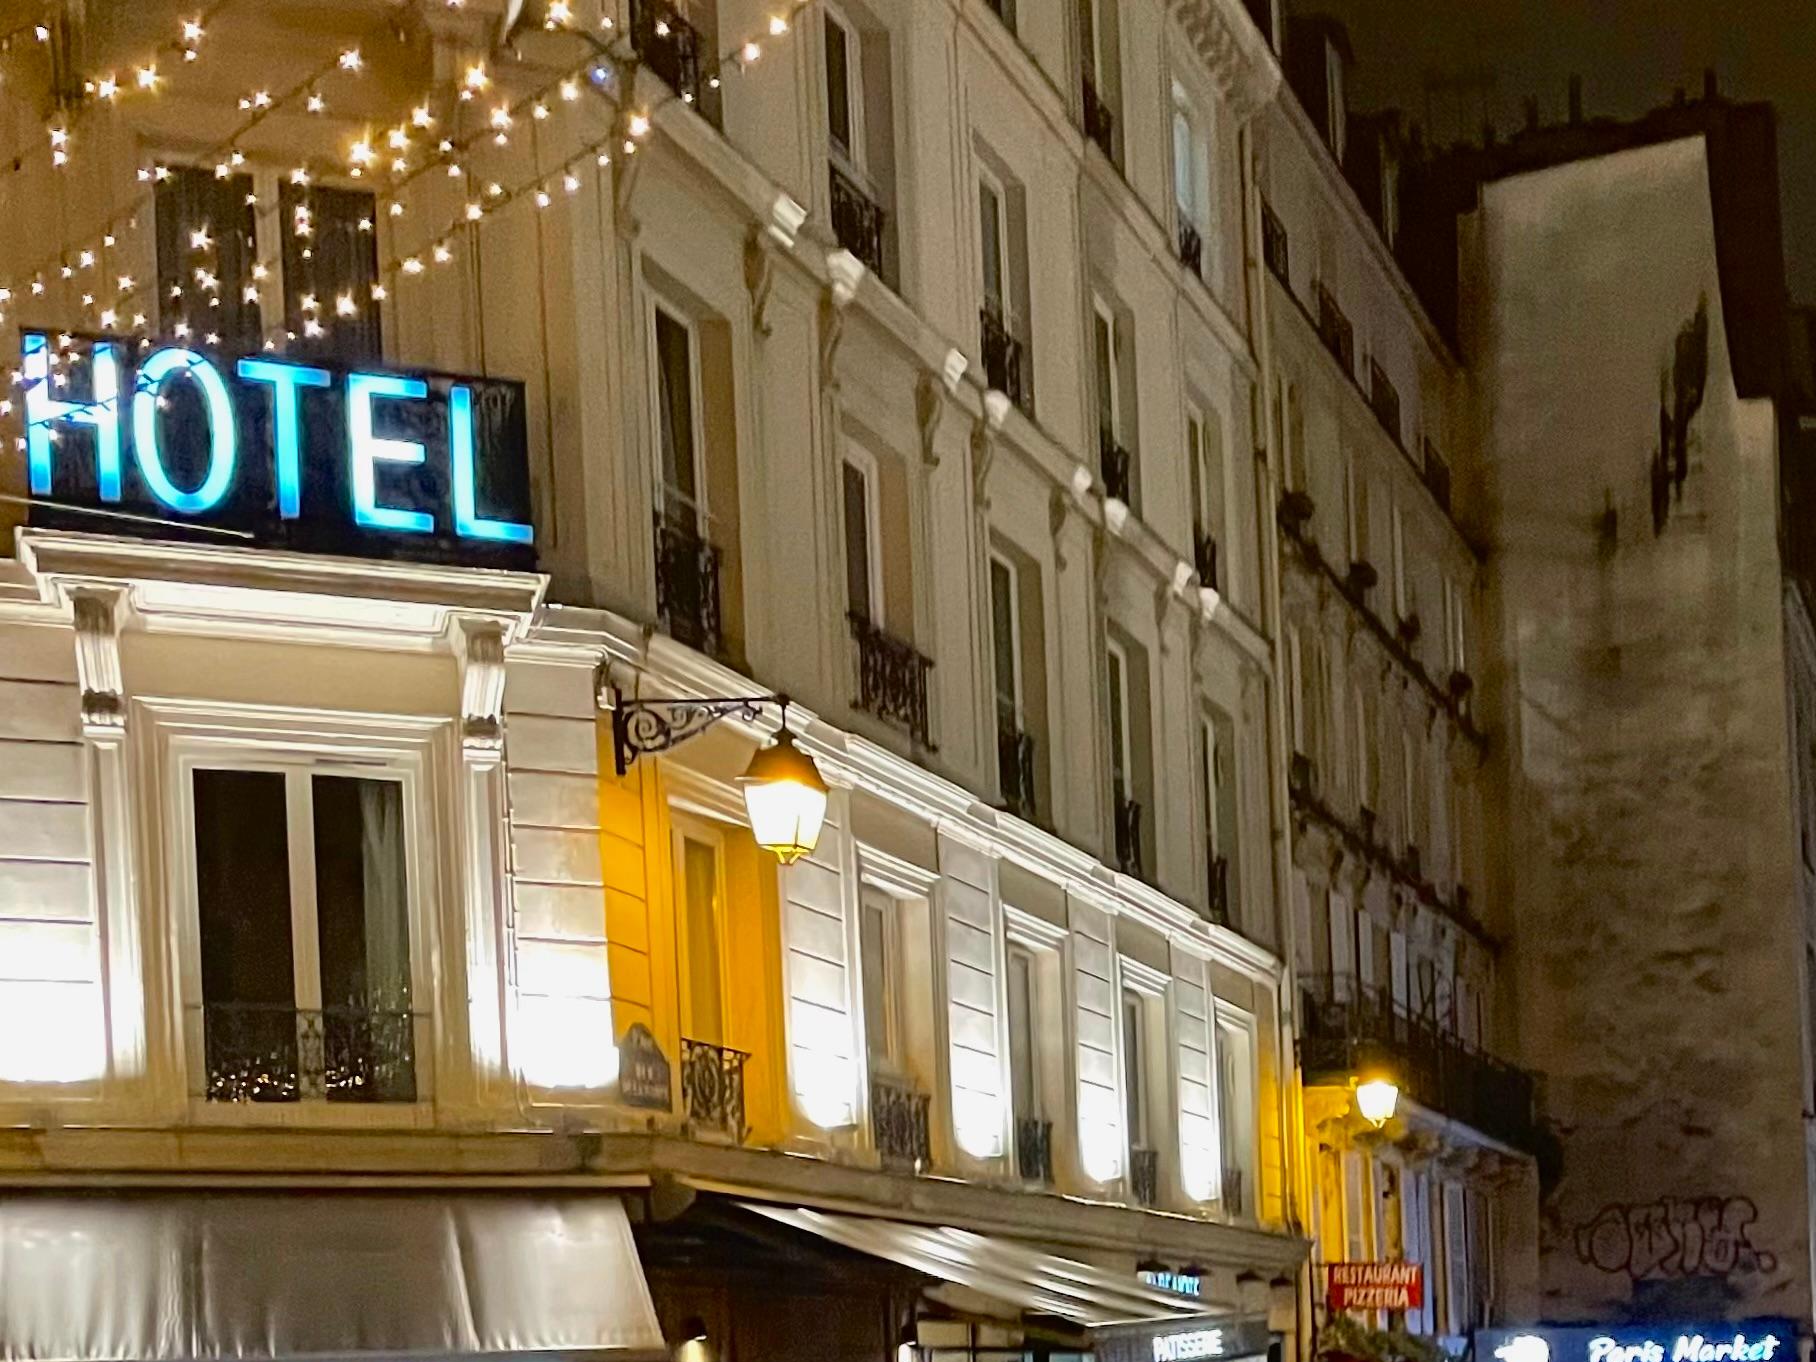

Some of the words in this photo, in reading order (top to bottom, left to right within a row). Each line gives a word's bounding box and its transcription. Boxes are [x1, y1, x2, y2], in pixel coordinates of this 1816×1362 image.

[22, 332, 534, 545] HOTEL
[1333, 1264, 1417, 1285] RESTAURANT
[1343, 1286, 1409, 1307] PIZZERIA
[1672, 1334, 1781, 1362] Market
